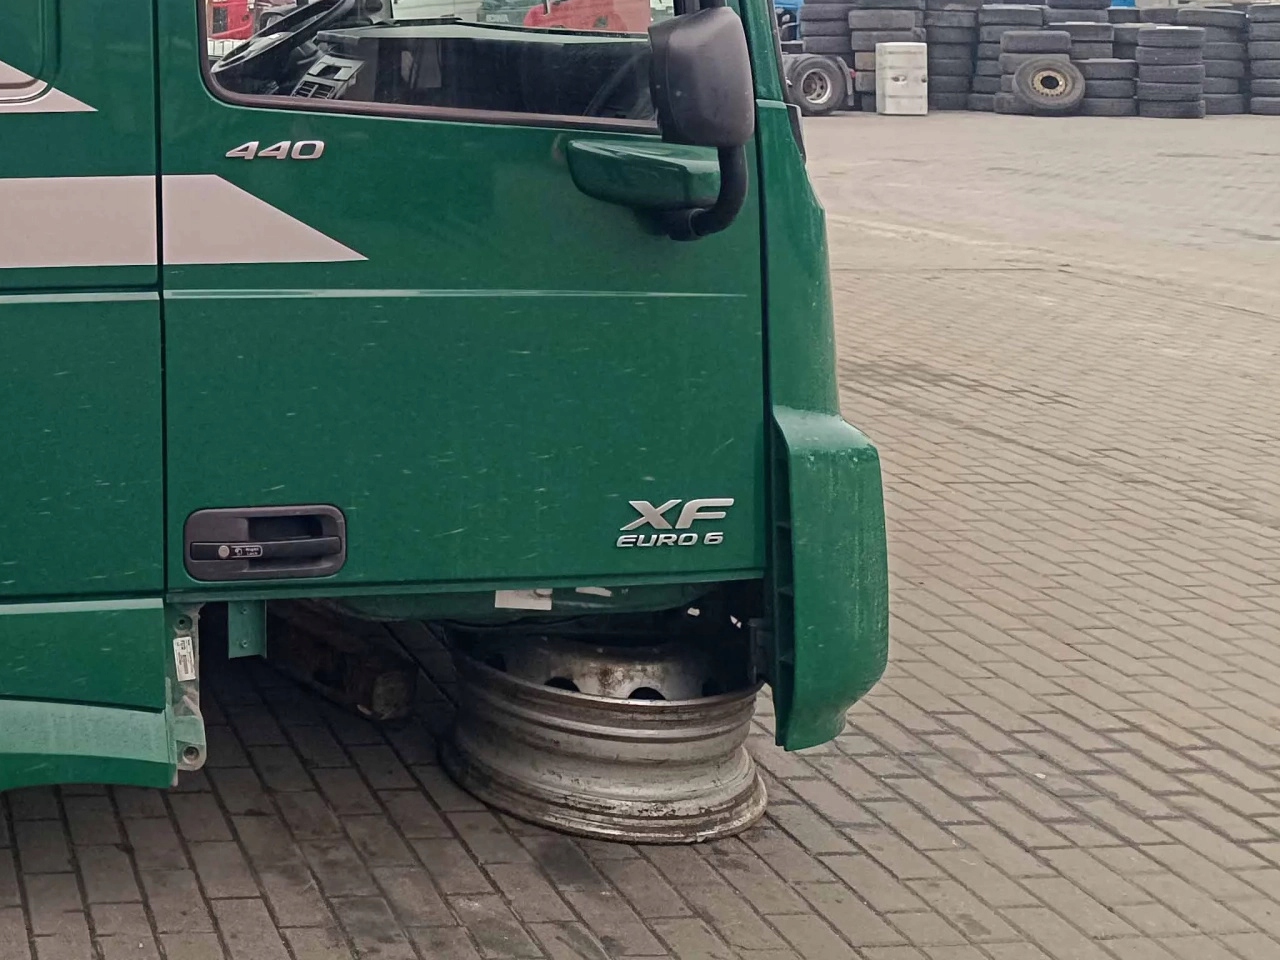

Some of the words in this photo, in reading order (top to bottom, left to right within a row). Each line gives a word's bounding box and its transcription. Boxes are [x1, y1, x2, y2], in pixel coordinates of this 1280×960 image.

[225, 140, 325, 160] 440
[619, 498, 735, 530] XF
[616, 533, 699, 548] EURO
[703, 531, 724, 545] 6
